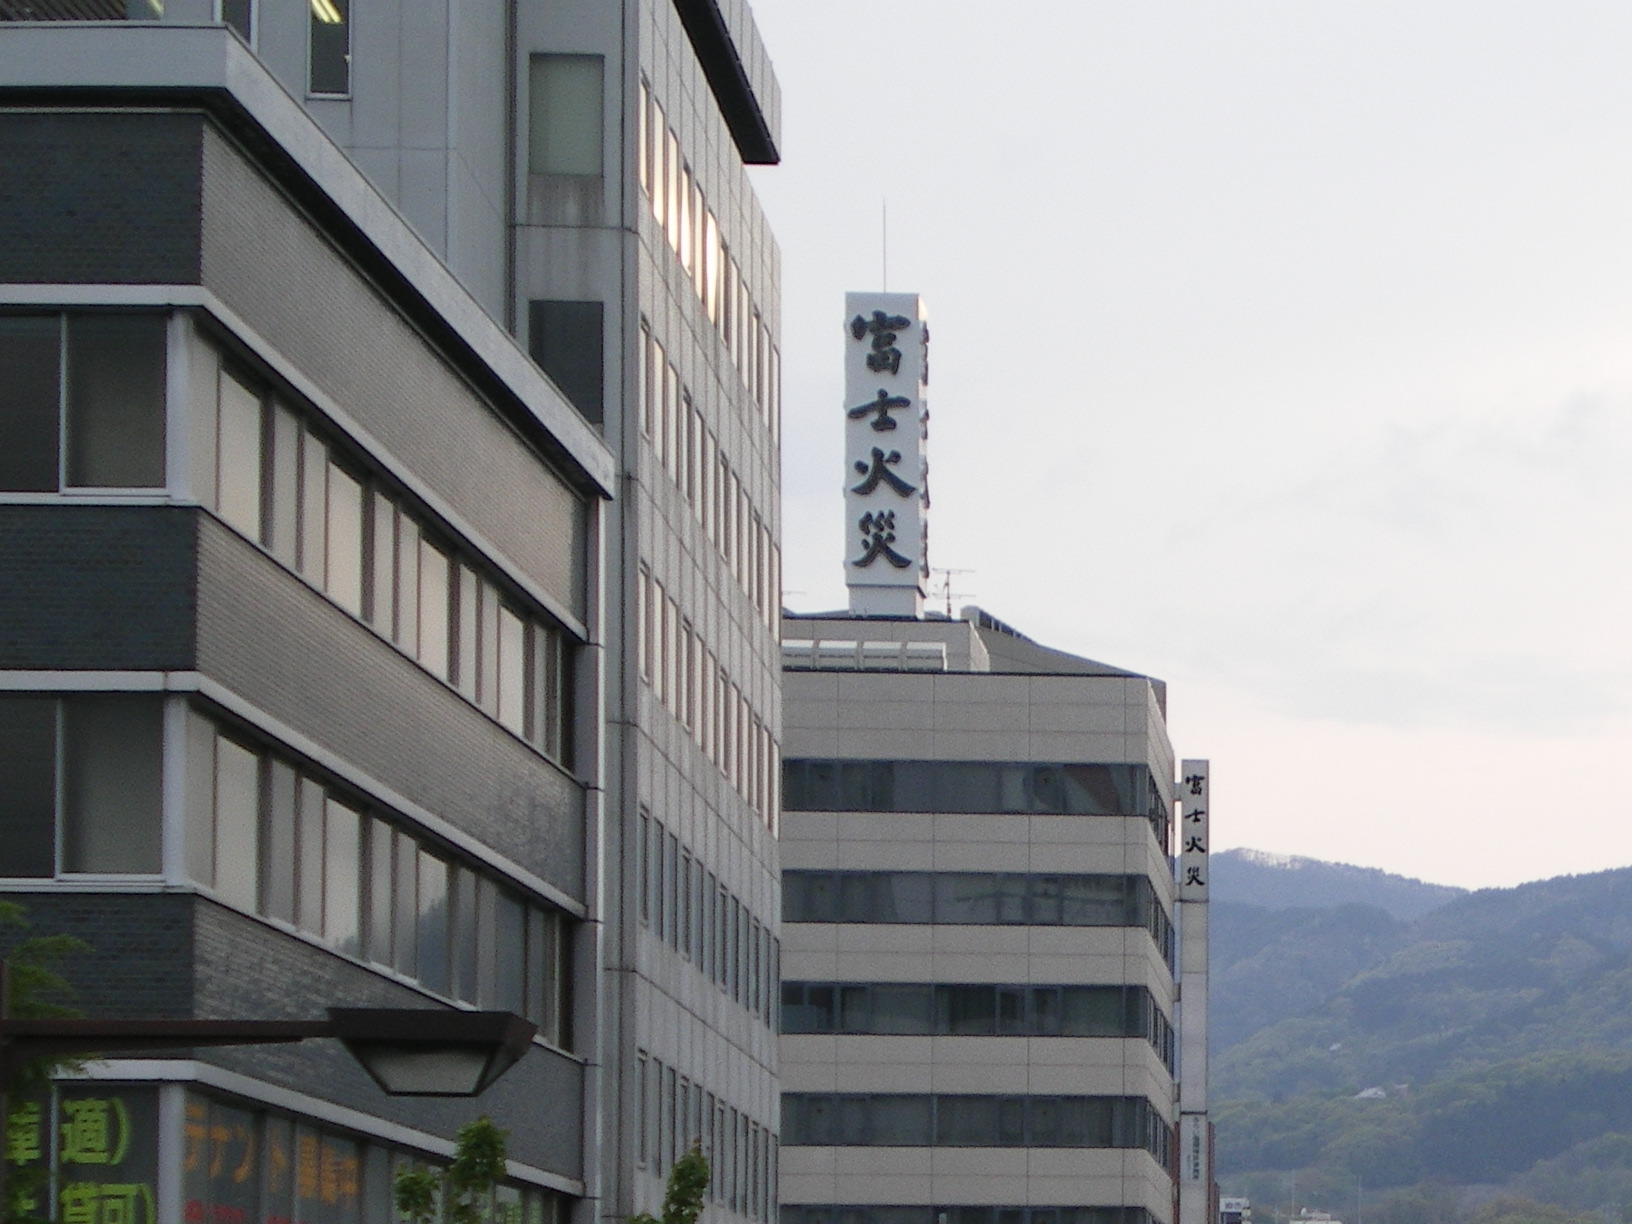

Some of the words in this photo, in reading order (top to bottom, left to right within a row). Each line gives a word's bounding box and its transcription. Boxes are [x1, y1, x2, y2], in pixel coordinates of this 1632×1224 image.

[848, 309, 917, 568] 富士火災
[1185, 773, 1205, 886] 富士火災
